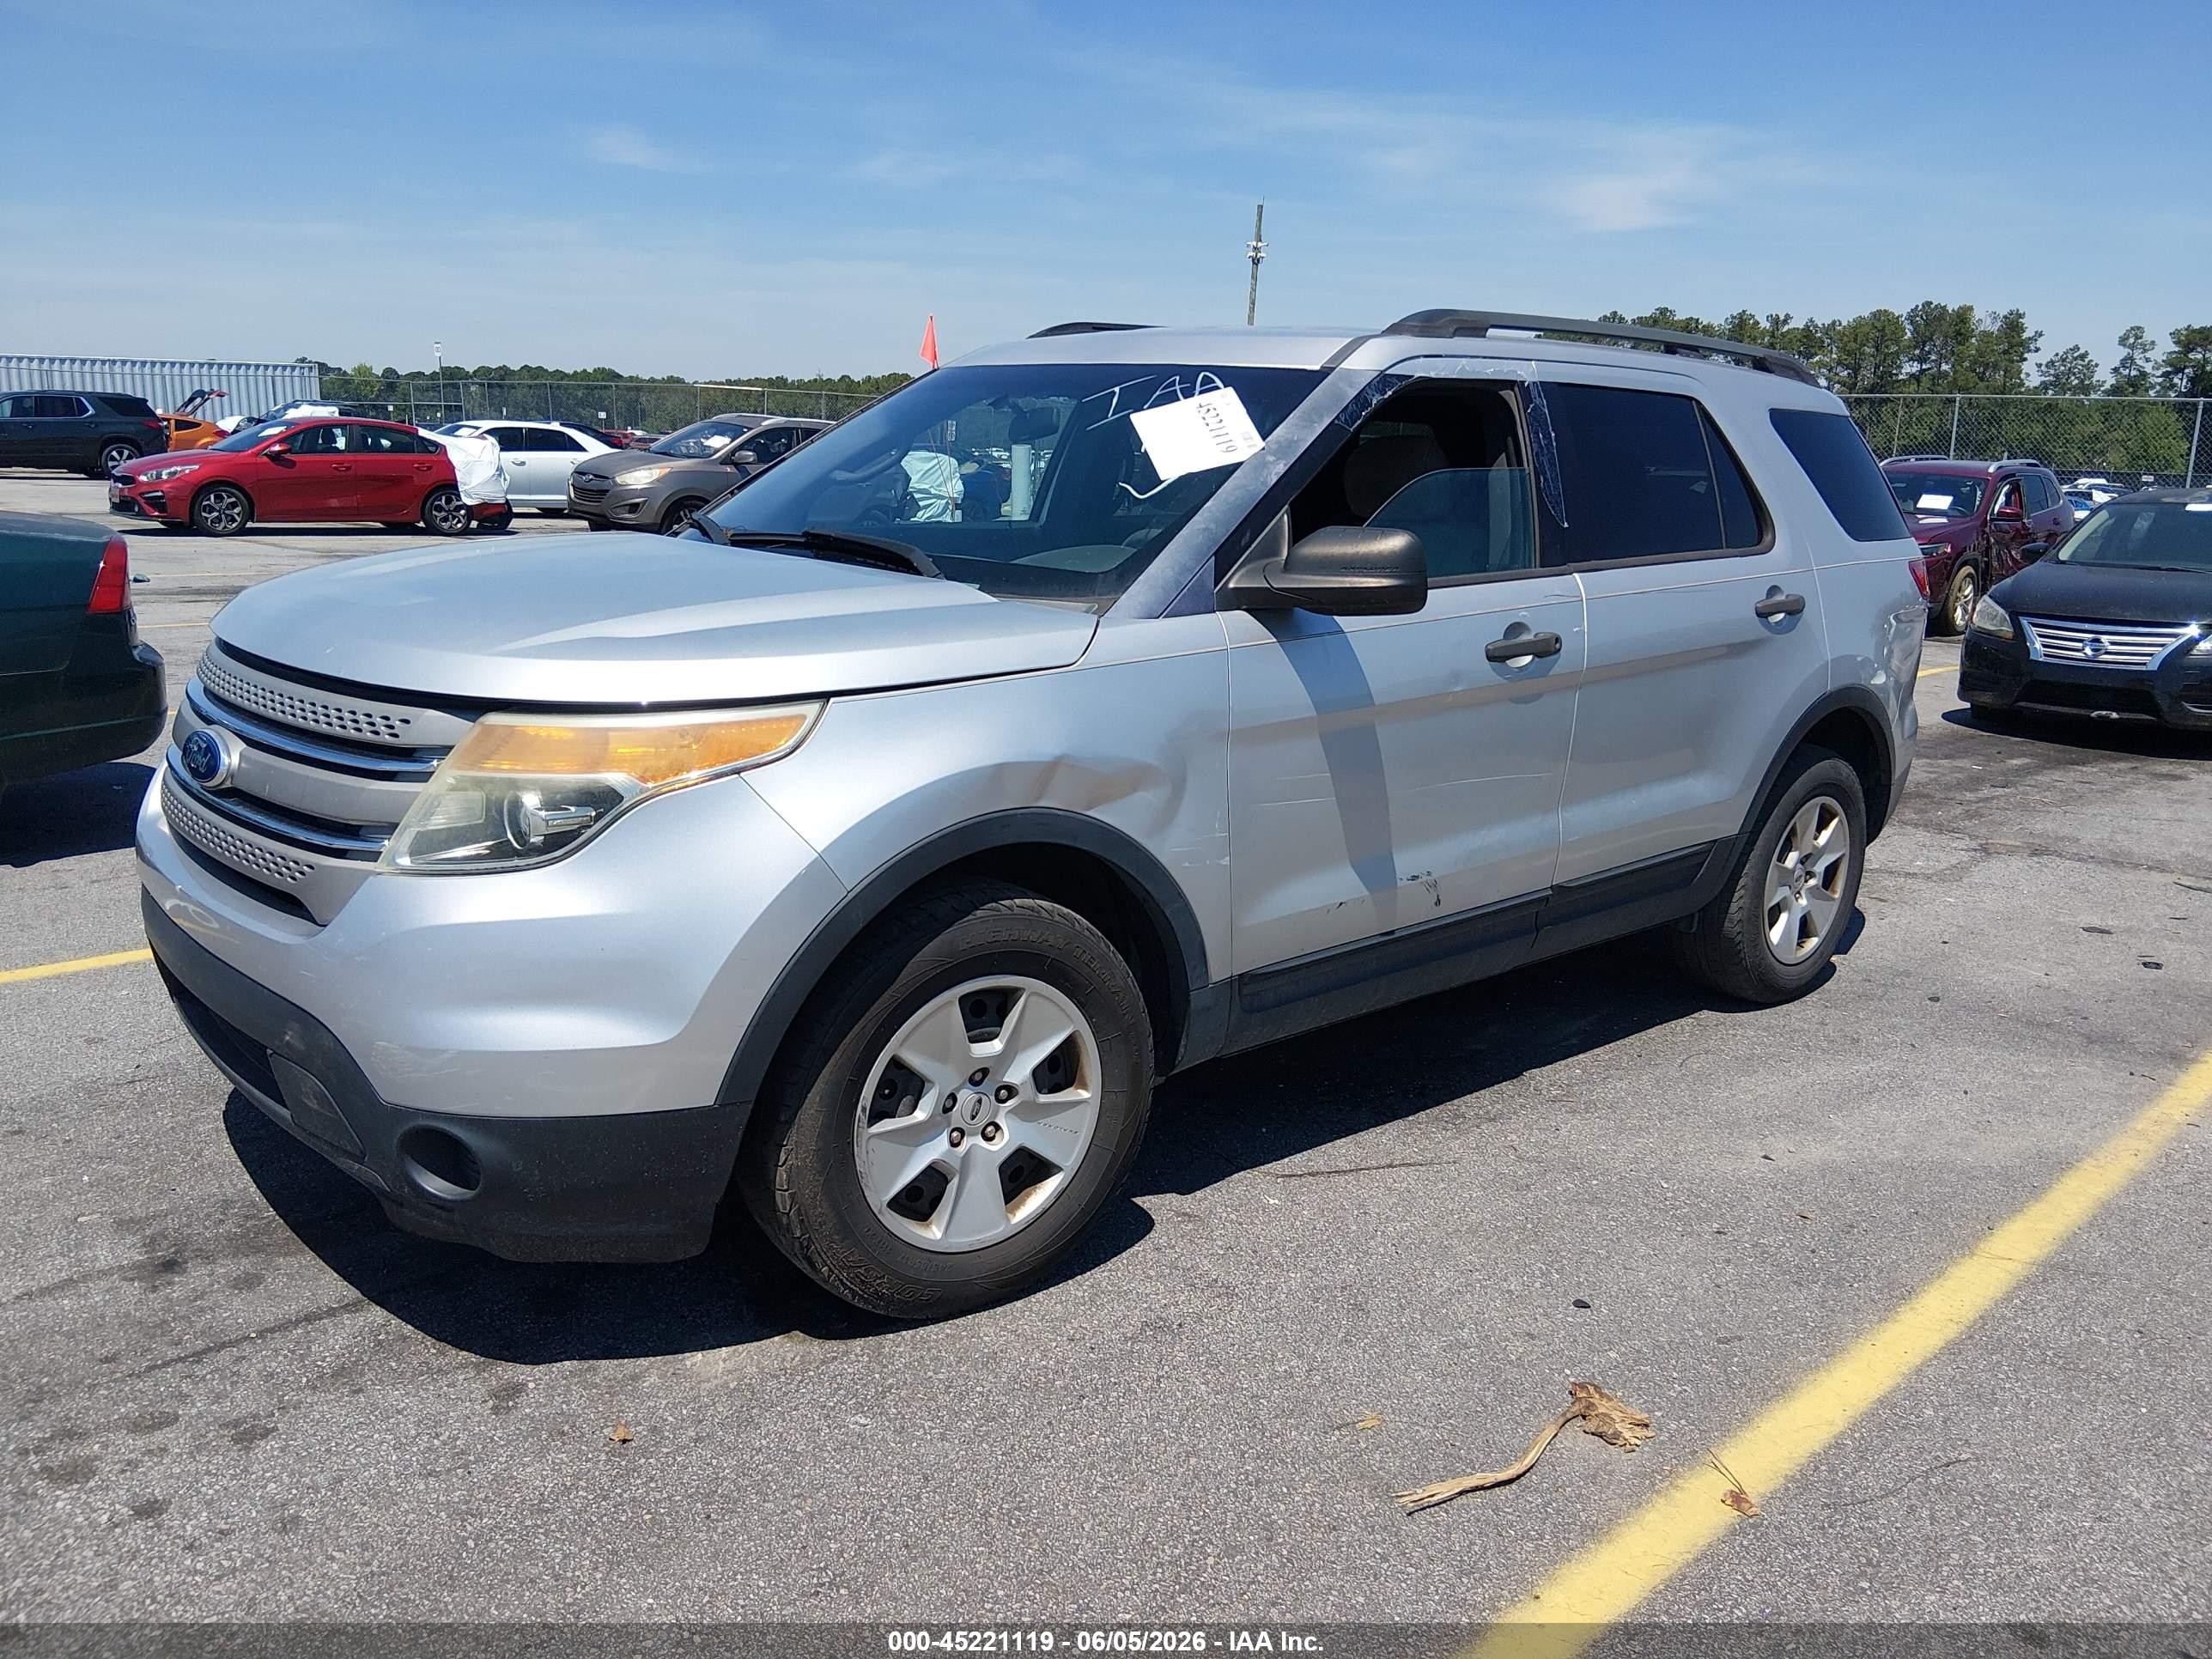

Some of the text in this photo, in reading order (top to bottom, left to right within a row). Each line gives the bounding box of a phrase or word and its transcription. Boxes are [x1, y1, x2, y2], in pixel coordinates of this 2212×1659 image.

[1081, 371, 1224, 431] IAA
[1195, 401, 1238, 454] 45221119
[186, 738, 211, 773] Ford
